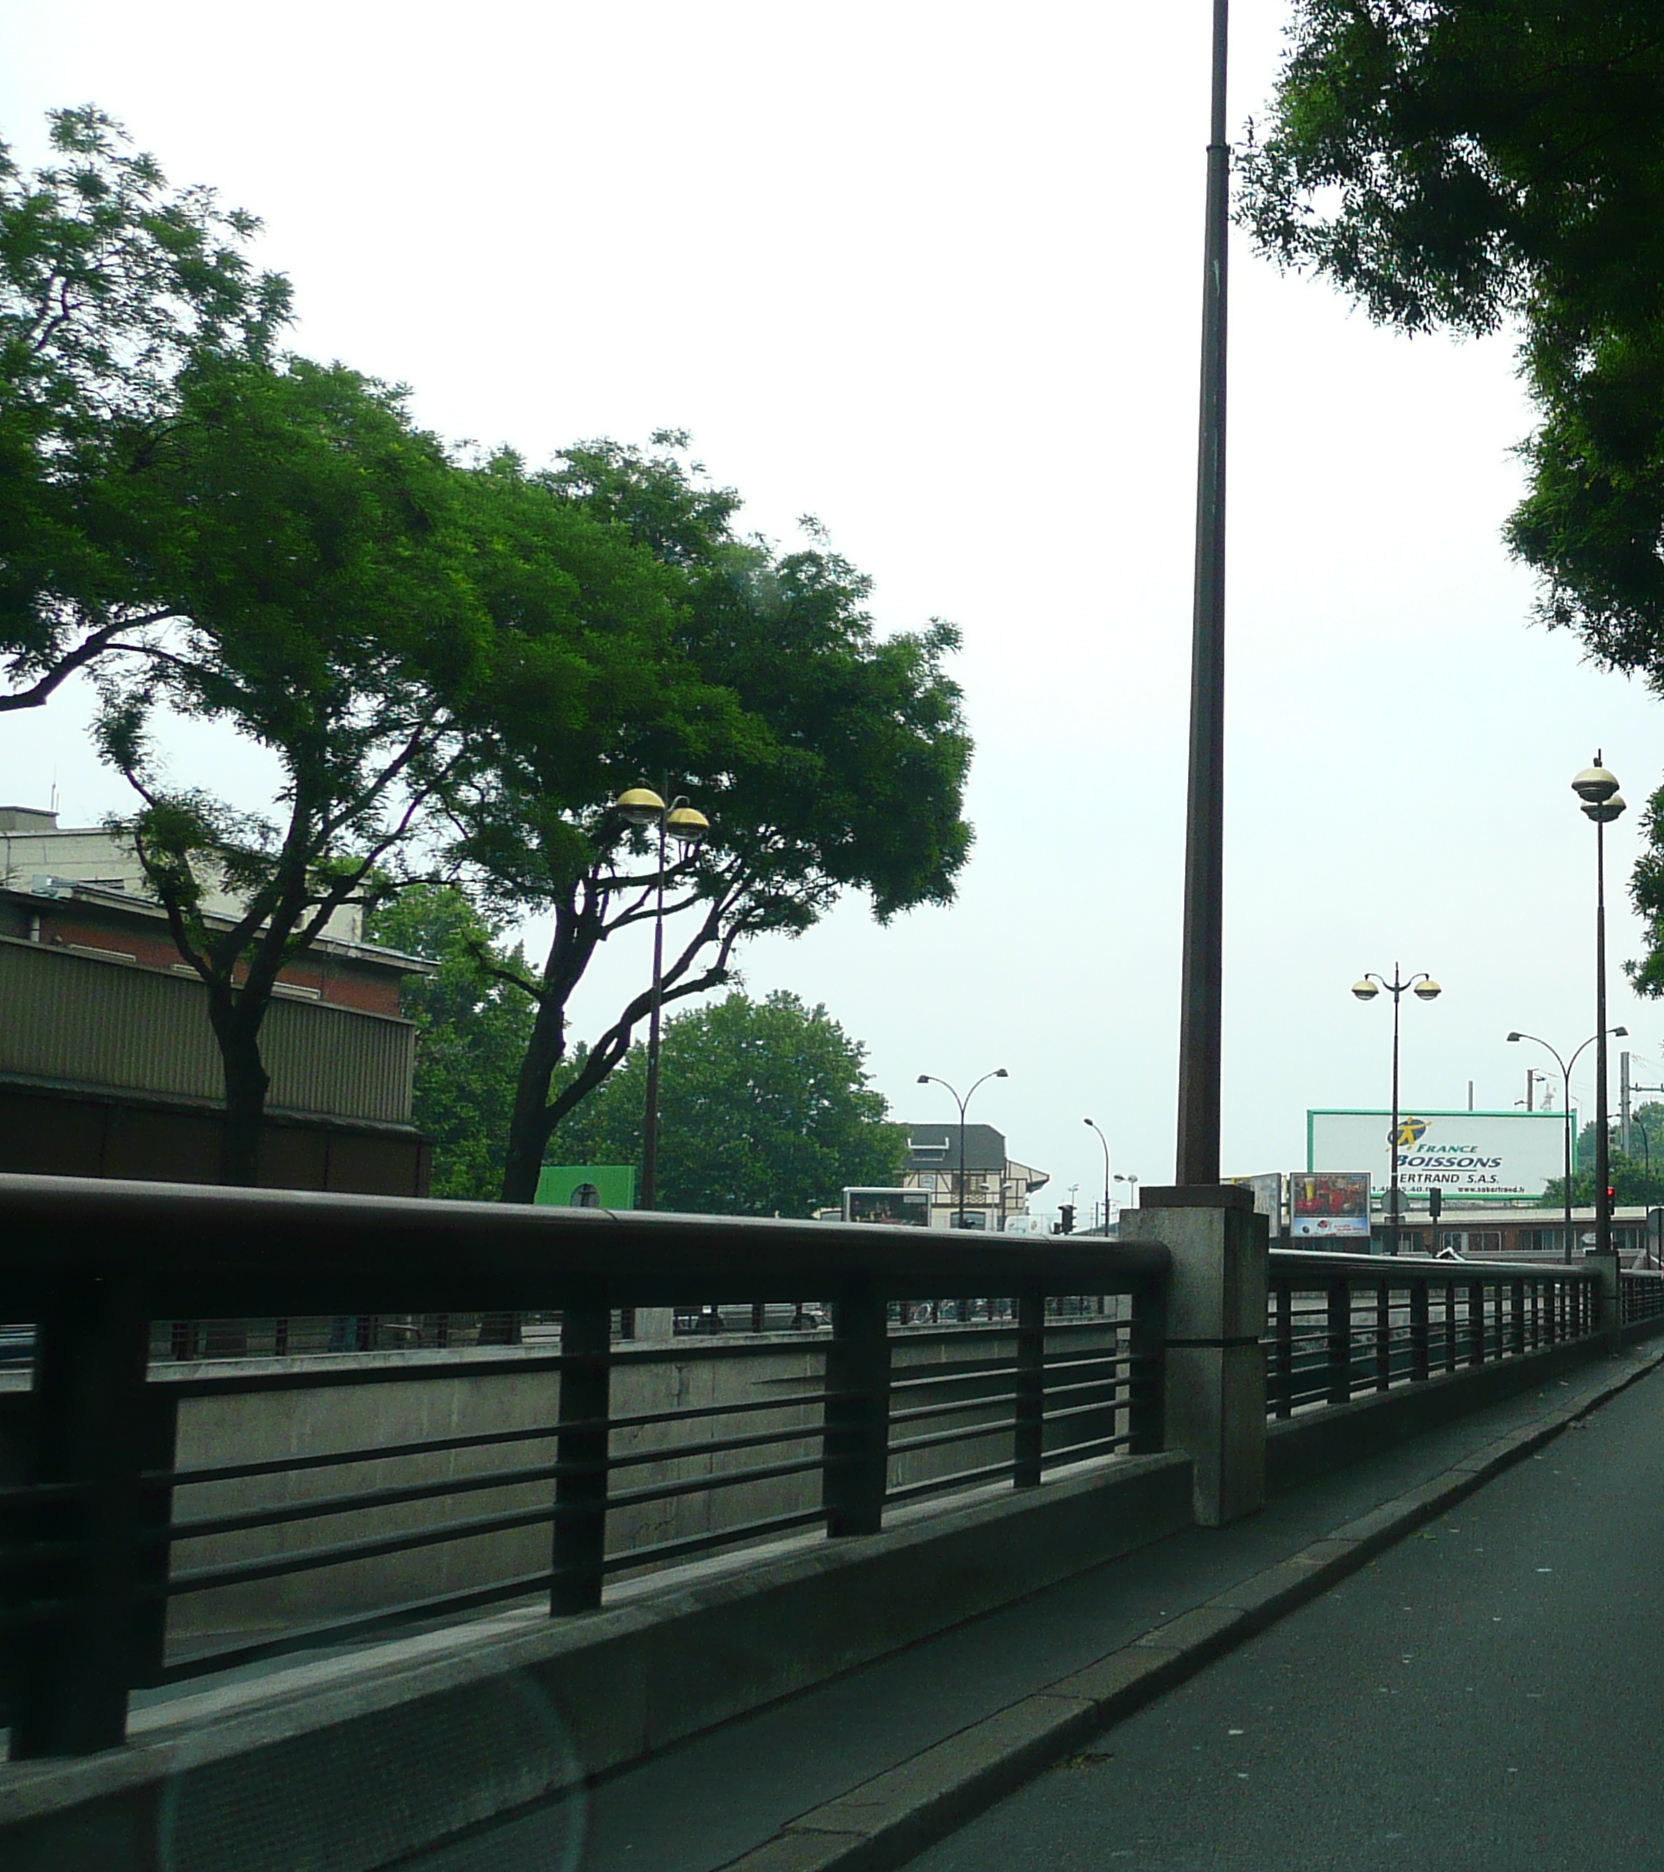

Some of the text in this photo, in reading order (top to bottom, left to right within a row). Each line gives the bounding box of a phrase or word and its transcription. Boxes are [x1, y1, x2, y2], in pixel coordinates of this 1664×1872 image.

[1416, 1143, 1479, 1153] FRANCE
[1397, 1154, 1503, 1168] BOISSONS
[1399, 1173, 1500, 1184] ERTRAND S.A.S.
